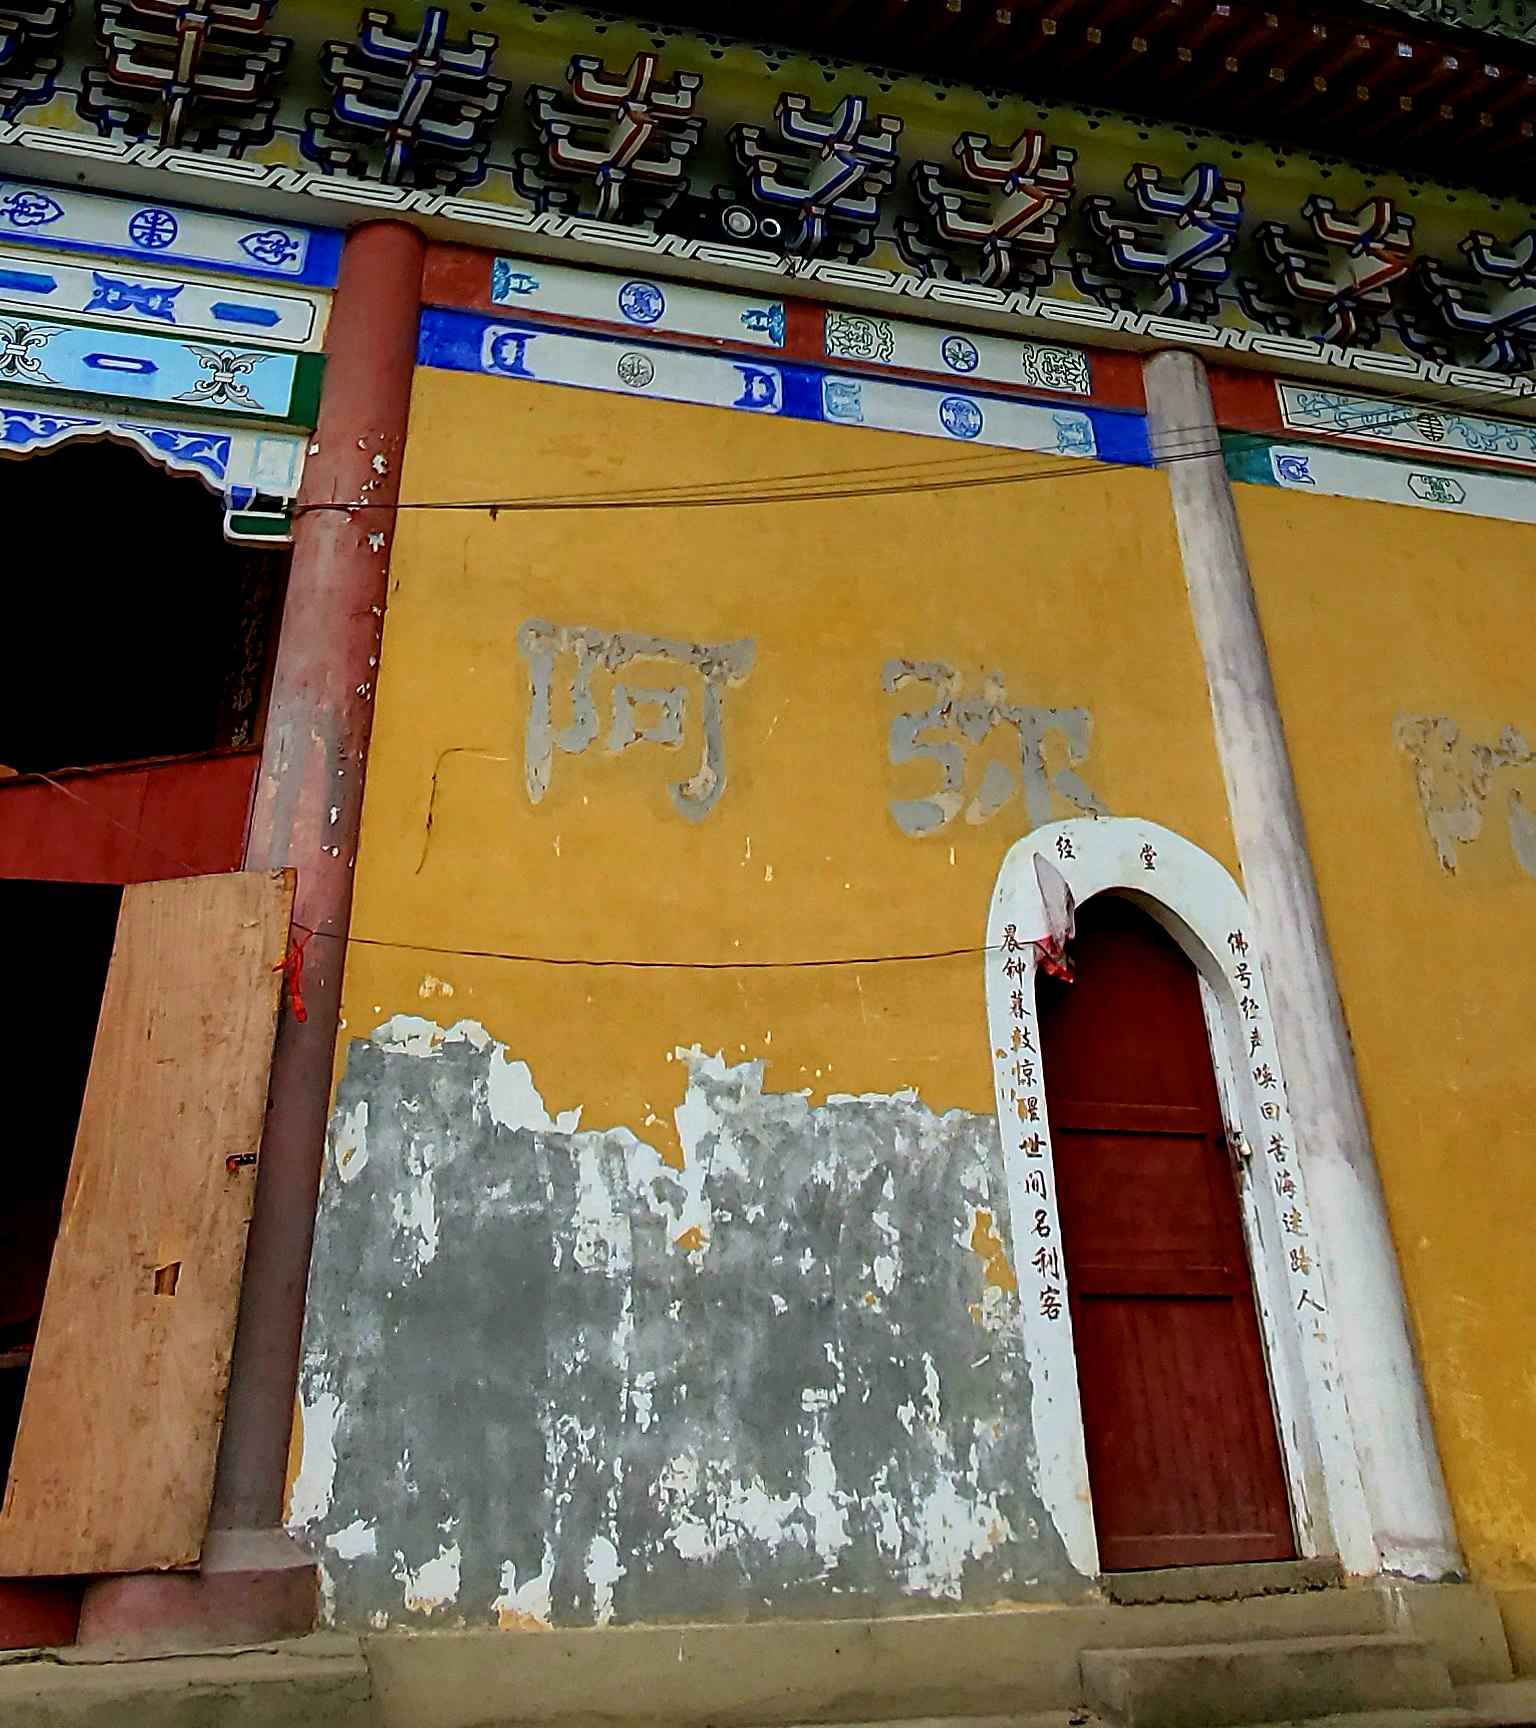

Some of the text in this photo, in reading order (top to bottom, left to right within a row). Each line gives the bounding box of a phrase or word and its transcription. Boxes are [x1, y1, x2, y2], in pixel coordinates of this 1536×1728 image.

[1056, 835, 1157, 870] 经堂
[1227, 929, 1325, 1312] 佛号经声唤回苦海迷路人
